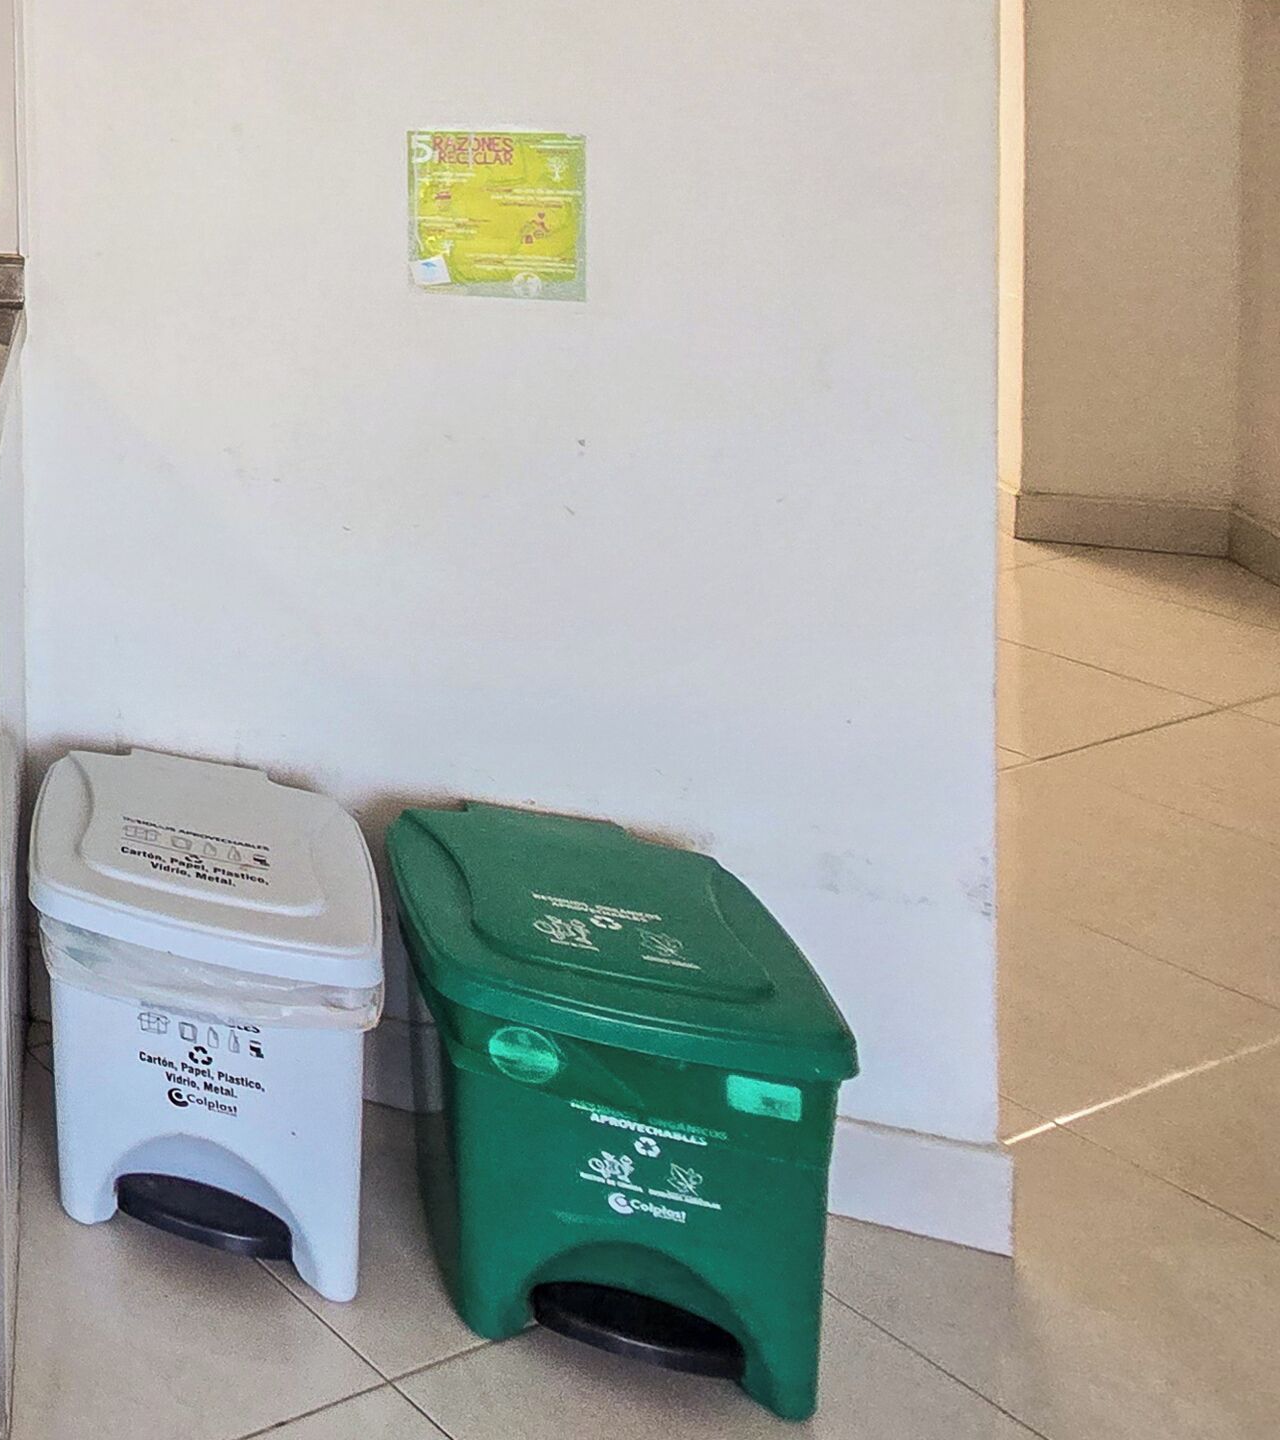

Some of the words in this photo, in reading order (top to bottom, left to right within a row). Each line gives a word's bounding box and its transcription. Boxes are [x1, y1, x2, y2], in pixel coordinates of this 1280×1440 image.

[411, 134, 433, 164] 5
[121, 846, 166, 864] Cartón,
[139, 1051, 178, 1071] Cartón,
[181, 1062, 215, 1080] Papel,
[217, 1071, 266, 1092] Plastico,
[165, 1071, 200, 1090] Vidrio,
[203, 1081, 238, 1098] Metal.
[186, 1093, 237, 1114] Colplast
